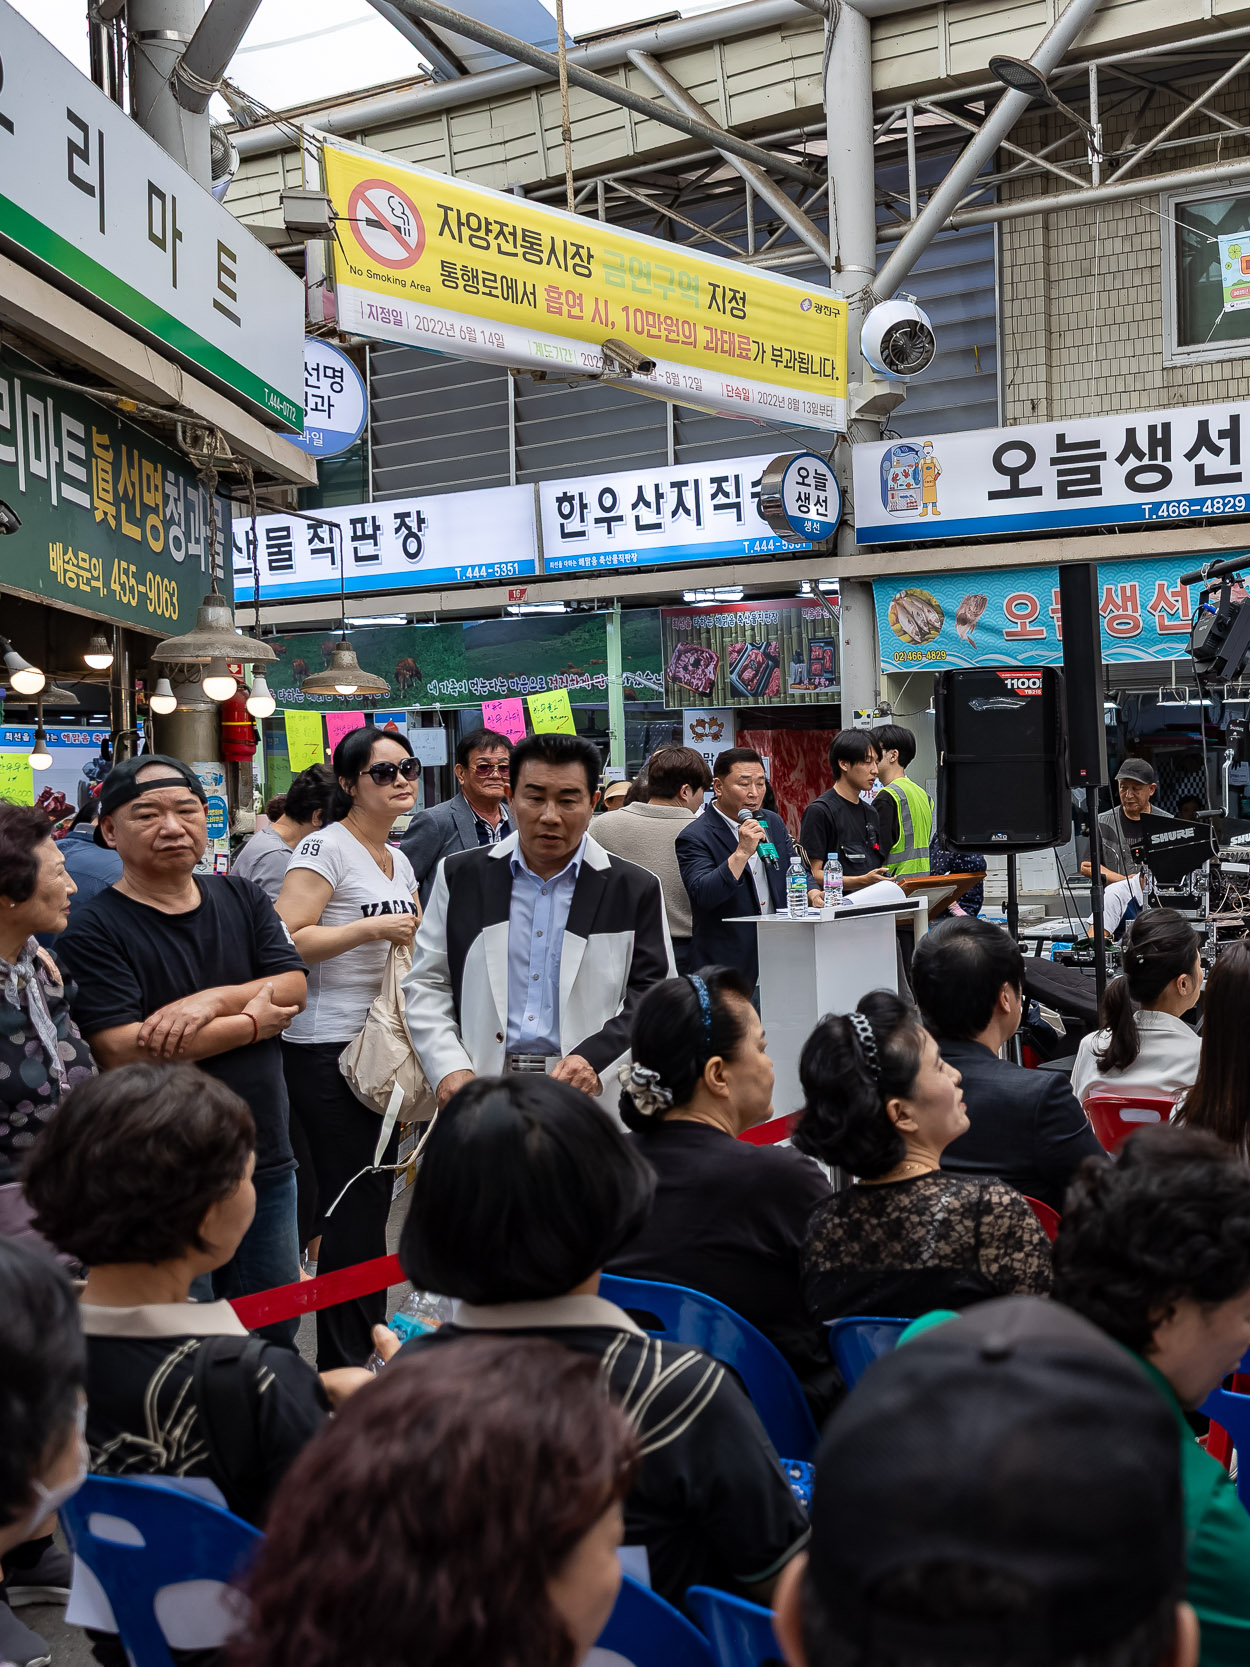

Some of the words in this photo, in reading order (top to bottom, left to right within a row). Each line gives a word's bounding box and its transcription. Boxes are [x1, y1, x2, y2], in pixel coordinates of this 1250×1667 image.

[437, 203, 594, 279] 자양전통시장
[602, 249, 700, 309] 금연구역
[707, 281, 747, 320] 지정
[349, 264, 363, 277] No
[366, 270, 406, 288] Smoking
[410, 280, 431, 293] Area
[440, 259, 537, 309] 통행로에서
[544, 284, 584, 320] 흡연
[590, 297, 616, 330] 시,
[621, 305, 697, 349] 10만원의
[703, 325, 766, 364] 과태료가
[770, 344, 839, 381] 부과됩니다.
[814, 302, 840, 318] 광진구
[367, 303, 403, 327] 지정일
[414, 315, 455, 339] 2022년
[459, 325, 477, 343] 6월
[480, 330, 505, 349] 14일
[683, 375, 703, 391] 12일
[726, 384, 750, 402] 단속일
[757, 391, 785, 409] 2022년
[787, 398, 800, 412] 8월
[802, 400, 833, 418] 13일부터
[264, 387, 297, 422] T.444-0772
[987, 413, 1243, 502] 오늘생선
[795, 466, 828, 493] 오늘
[795, 491, 829, 518] 생선
[1141, 496, 1246, 520] T.466-4829
[804, 520, 821, 534] 생선
[454, 562, 519, 580] T.444-5351
[599, 552, 637, 565] 축산물직판장
[111, 558, 178, 620] 455-9063
[1003, 580, 1192, 642] 오생선
[894, 650, 947, 662] 02)466-4829
[1151, 827, 1195, 844] SHURE
[300, 843, 320, 856] 89
